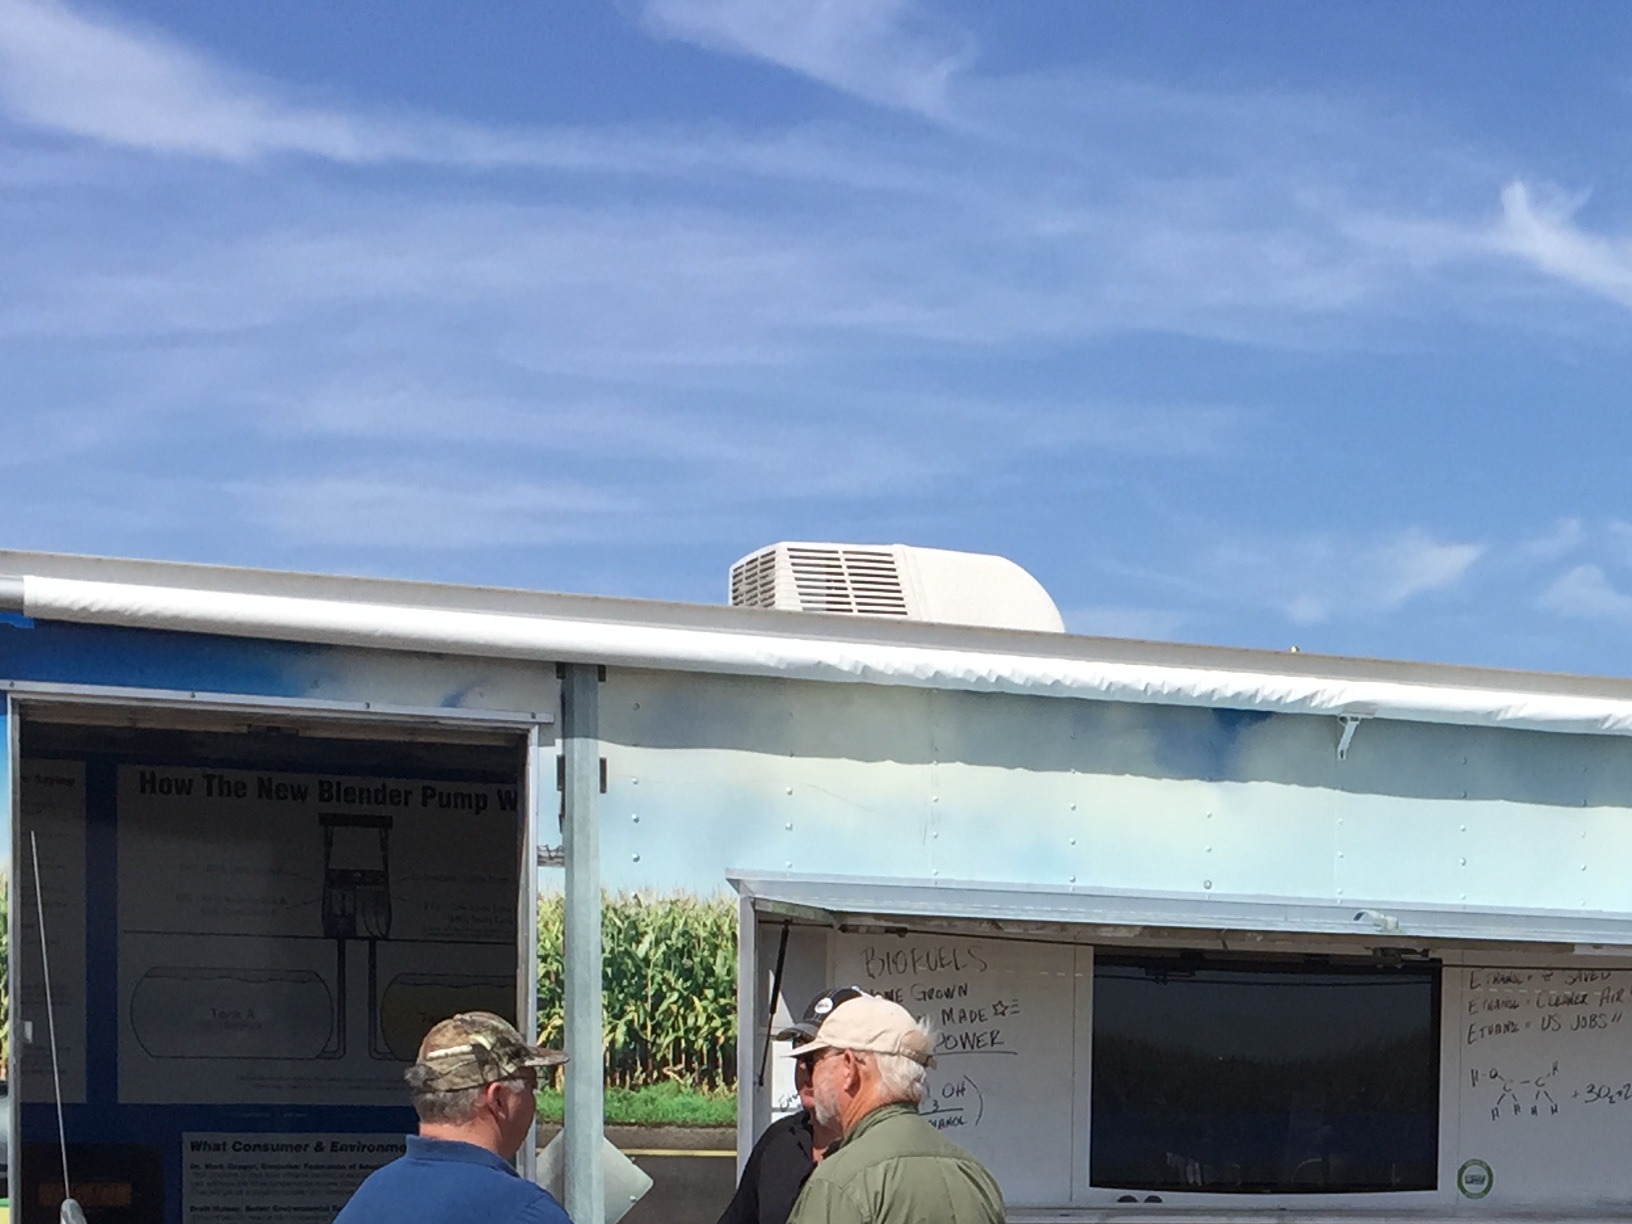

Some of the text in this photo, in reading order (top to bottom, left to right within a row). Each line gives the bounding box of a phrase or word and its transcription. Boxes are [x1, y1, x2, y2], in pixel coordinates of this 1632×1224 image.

[139, 770, 194, 796] How
[202, 773, 247, 799] The
[256, 776, 309, 803] New
[318, 780, 413, 807] Blender
[421, 785, 488, 815] Pump
[861, 945, 988, 979] BIOFUELS
[941, 1007, 988, 1026] MADE
[190, 1141, 226, 1152] What
[231, 1141, 309, 1153] Consumer
[313, 1141, 324, 1152] &
